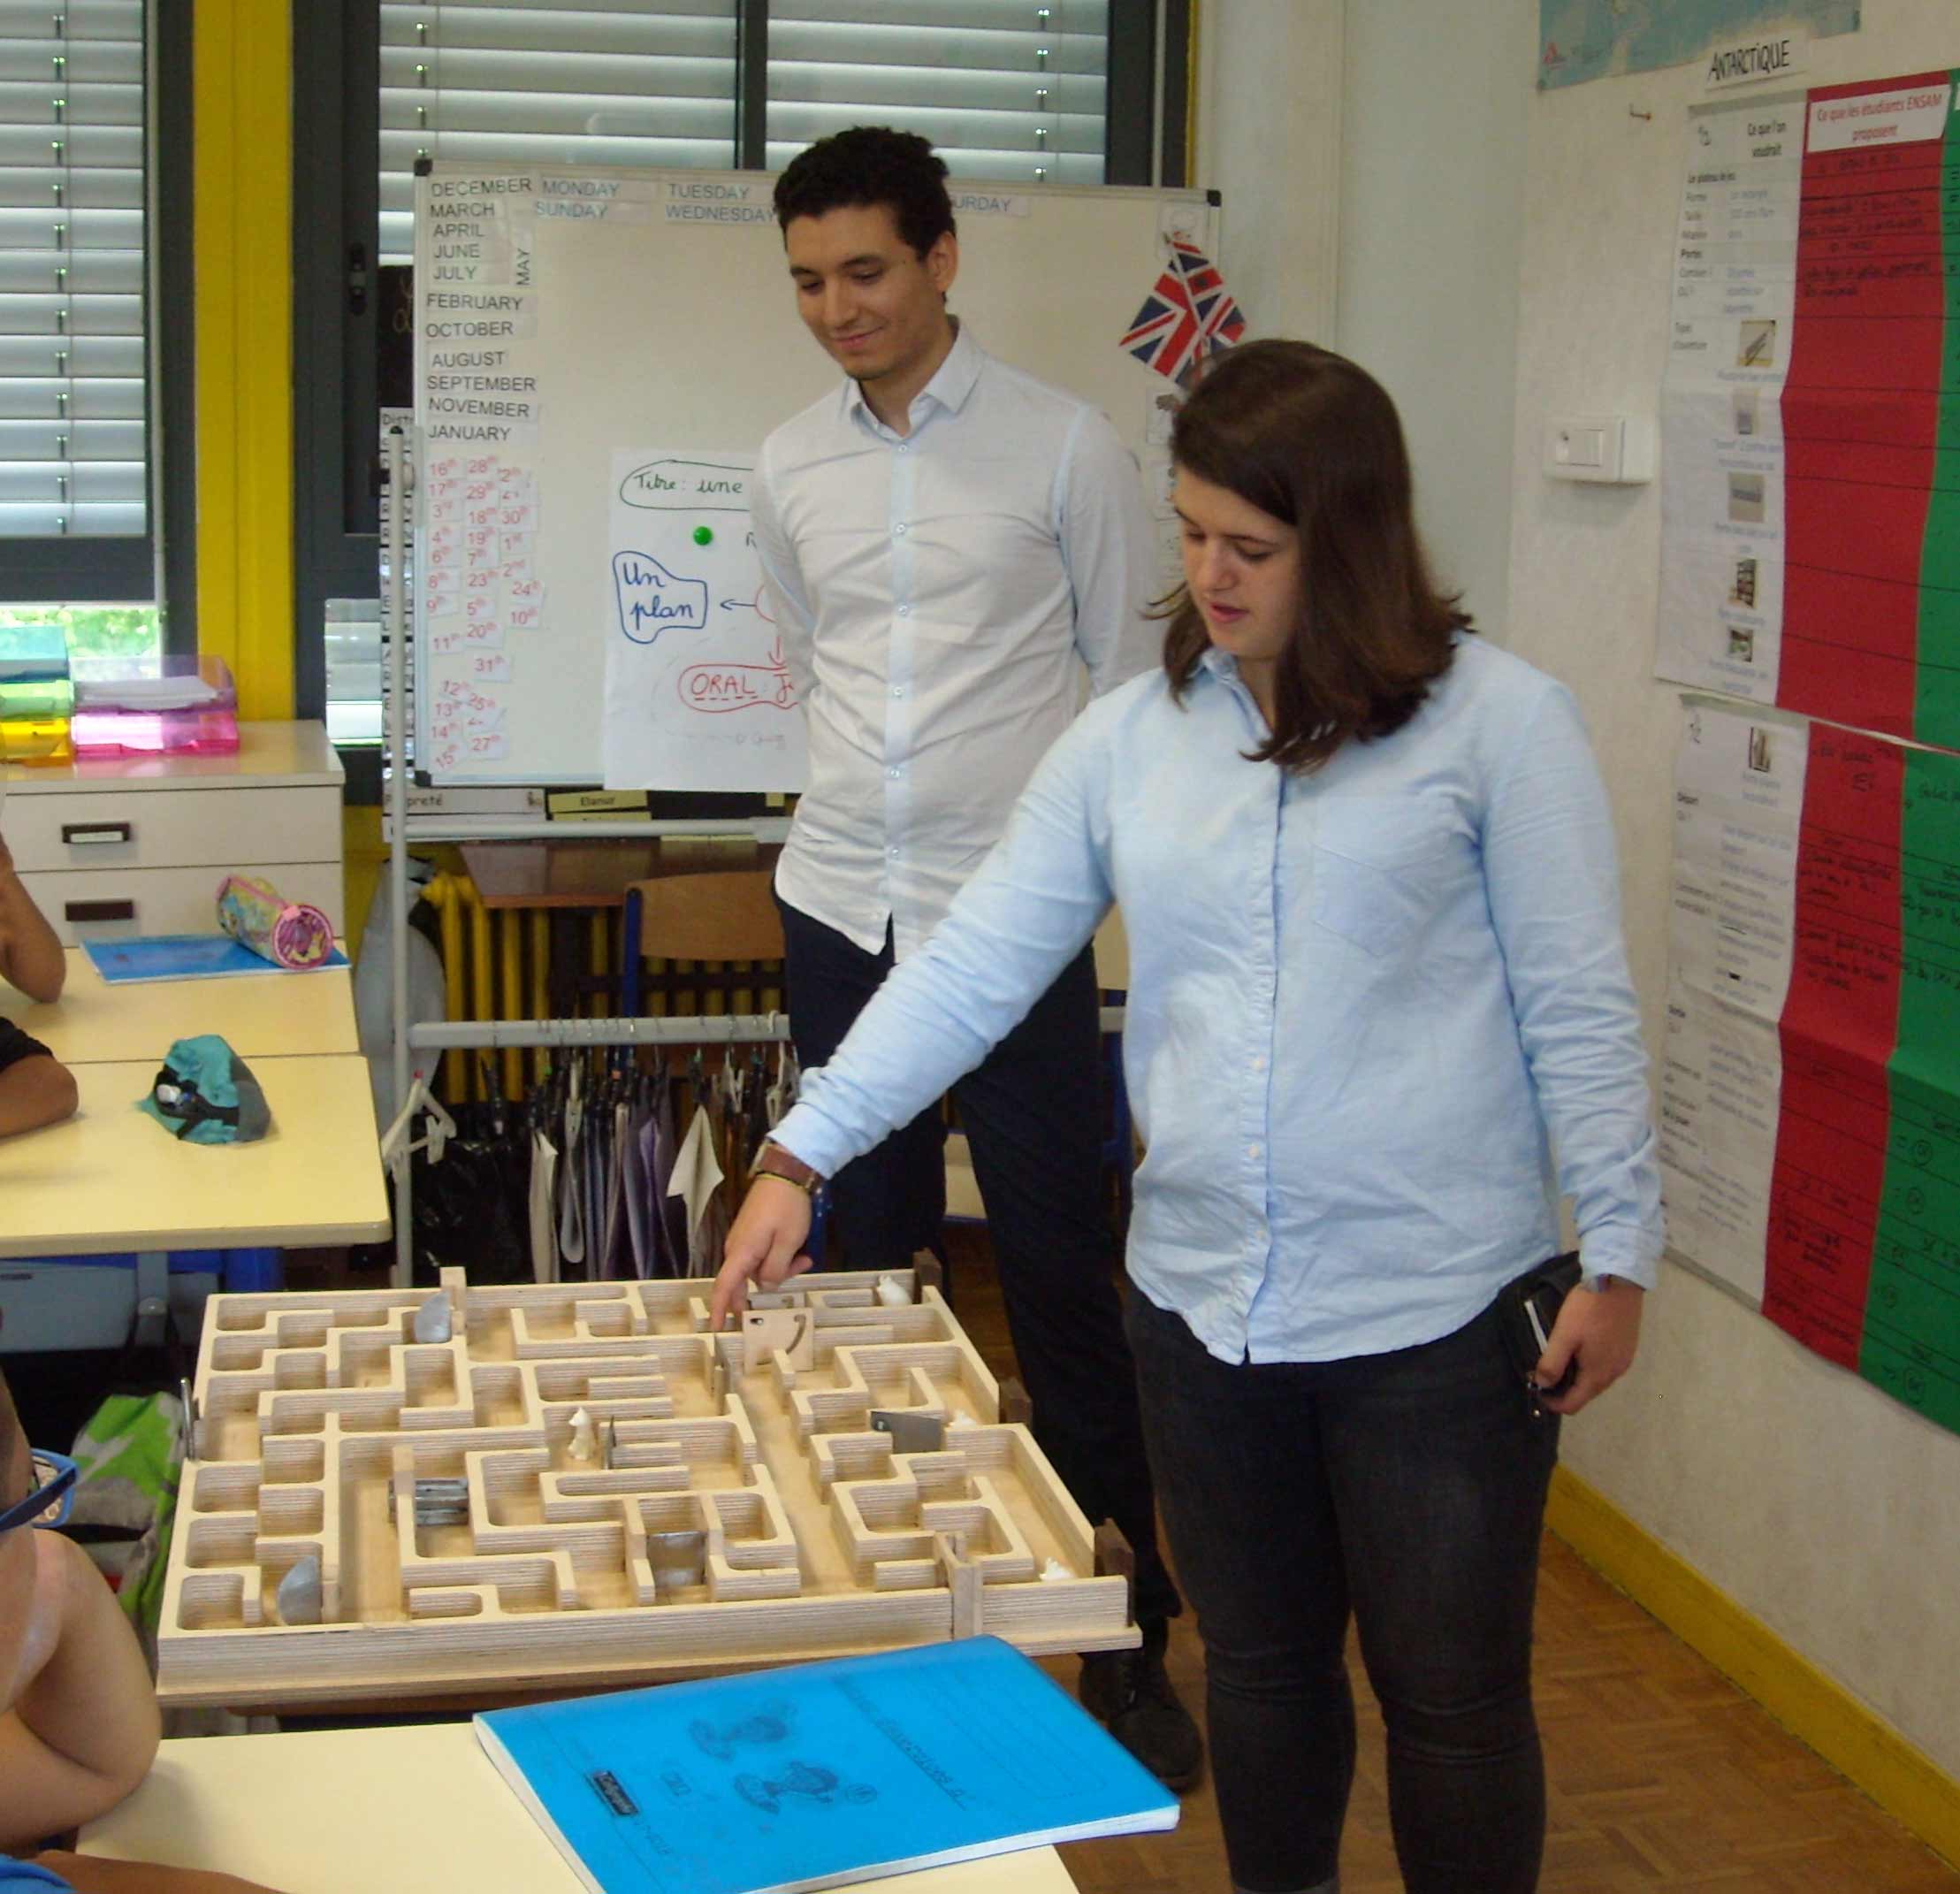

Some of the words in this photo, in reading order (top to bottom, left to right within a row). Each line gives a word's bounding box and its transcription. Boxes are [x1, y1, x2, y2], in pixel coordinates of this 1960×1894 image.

[1907, 92, 1942, 111] ENSAM
[431, 177, 532, 197] DECEMBER
[542, 179, 620, 198] MONDAY
[669, 183, 750, 201] TUESDAY
[430, 202, 496, 218] MARCH
[536, 200, 609, 219] SUNDAY
[953, 195, 1011, 213] URDAY
[665, 204, 777, 223] WEDNESDAY
[433, 223, 485, 239] APRIL
[433, 244, 480, 259] JUNE
[433, 265, 477, 281] JULY
[516, 248, 531, 286] MAY
[426, 293, 523, 311] FEBRUARY
[425, 321, 514, 338] OCTOBER
[431, 351, 505, 368] AUGUST
[427, 375, 537, 392] SEPTEMBER
[428, 397, 530, 417] NOVEMBER
[428, 424, 511, 442] JANUARY
[696, 479, 744, 494] une
[622, 561, 666, 588] Un
[629, 596, 694, 630] plan
